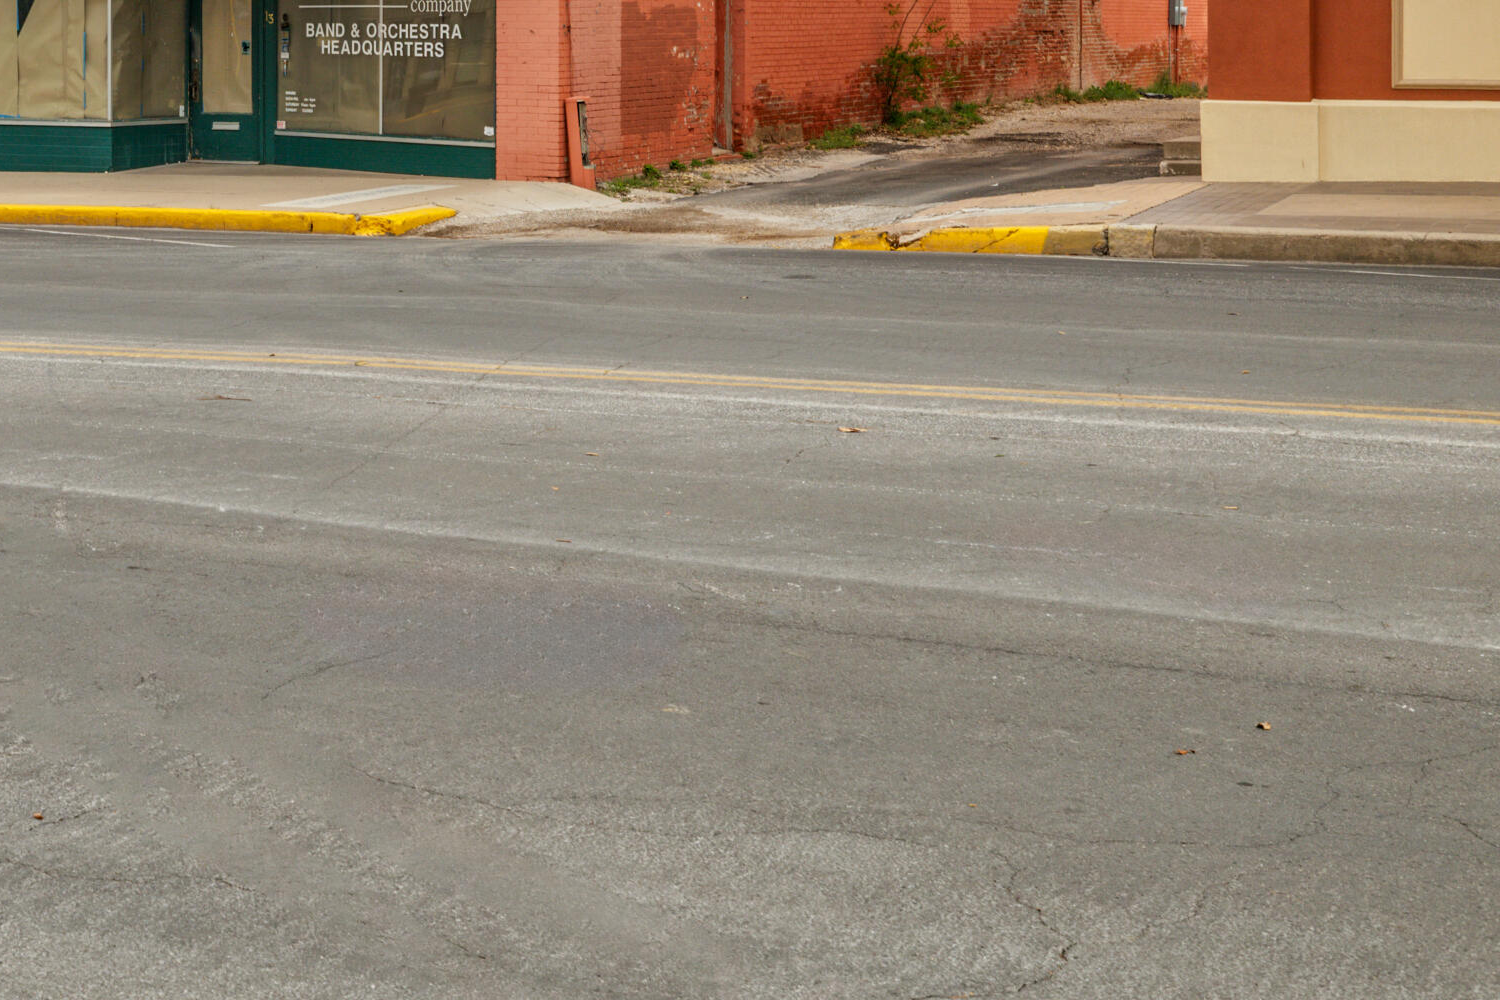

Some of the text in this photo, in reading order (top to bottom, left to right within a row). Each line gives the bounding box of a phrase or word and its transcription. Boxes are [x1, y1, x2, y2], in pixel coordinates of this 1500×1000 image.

[410, 0, 472, 17] company
[305, 22, 463, 40] BAND & ORCHESTRA
[321, 39, 445, 58] HEADQUARTERS
